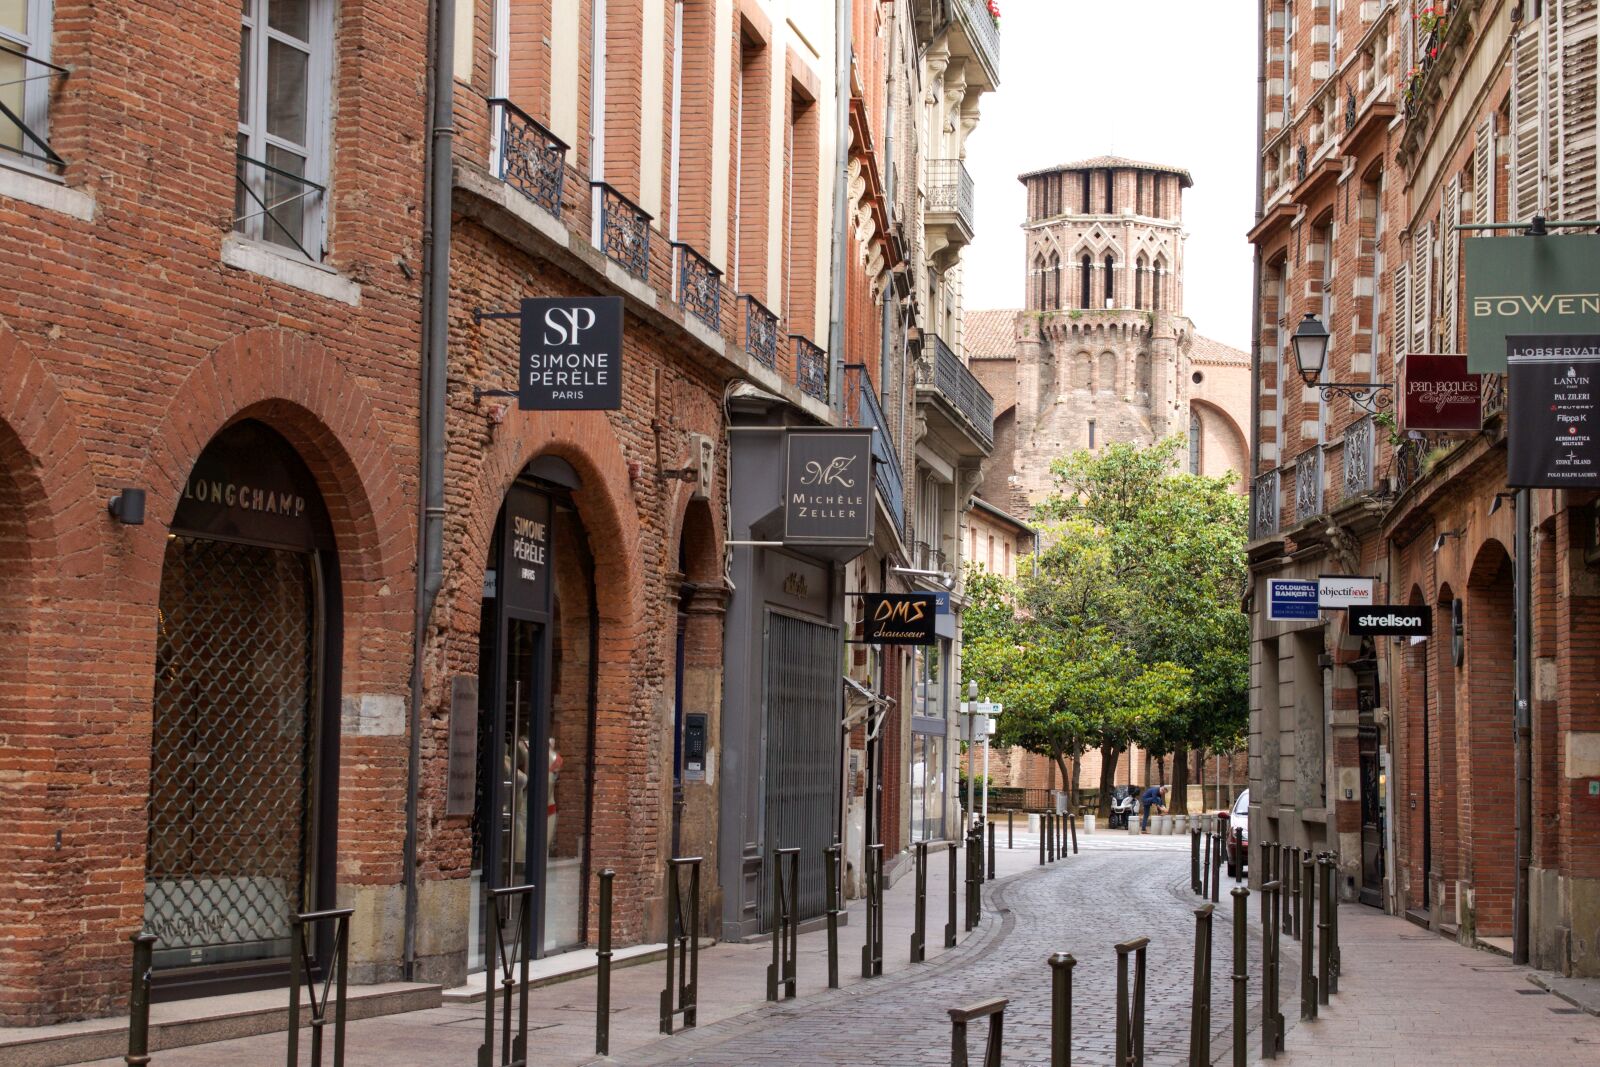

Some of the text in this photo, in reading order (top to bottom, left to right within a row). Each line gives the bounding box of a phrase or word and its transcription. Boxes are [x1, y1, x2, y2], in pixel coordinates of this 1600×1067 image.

[1474, 294, 1600, 316] BOWEN
[544, 307, 596, 346] SP
[530, 353, 608, 368] SIMONE
[530, 368, 608, 386] PÉRÈLE
[1554, 377, 1590, 385] LANVIN
[552, 391, 584, 399] PARIS
[184, 479, 306, 517] LONGCHAMP
[514, 516, 546, 542] SIMONE
[513, 537, 545, 565] PÉRÈLE
[874, 599, 926, 624] DMS
[1358, 614, 1422, 627] strellson
[873, 621, 926, 638] chausseur
